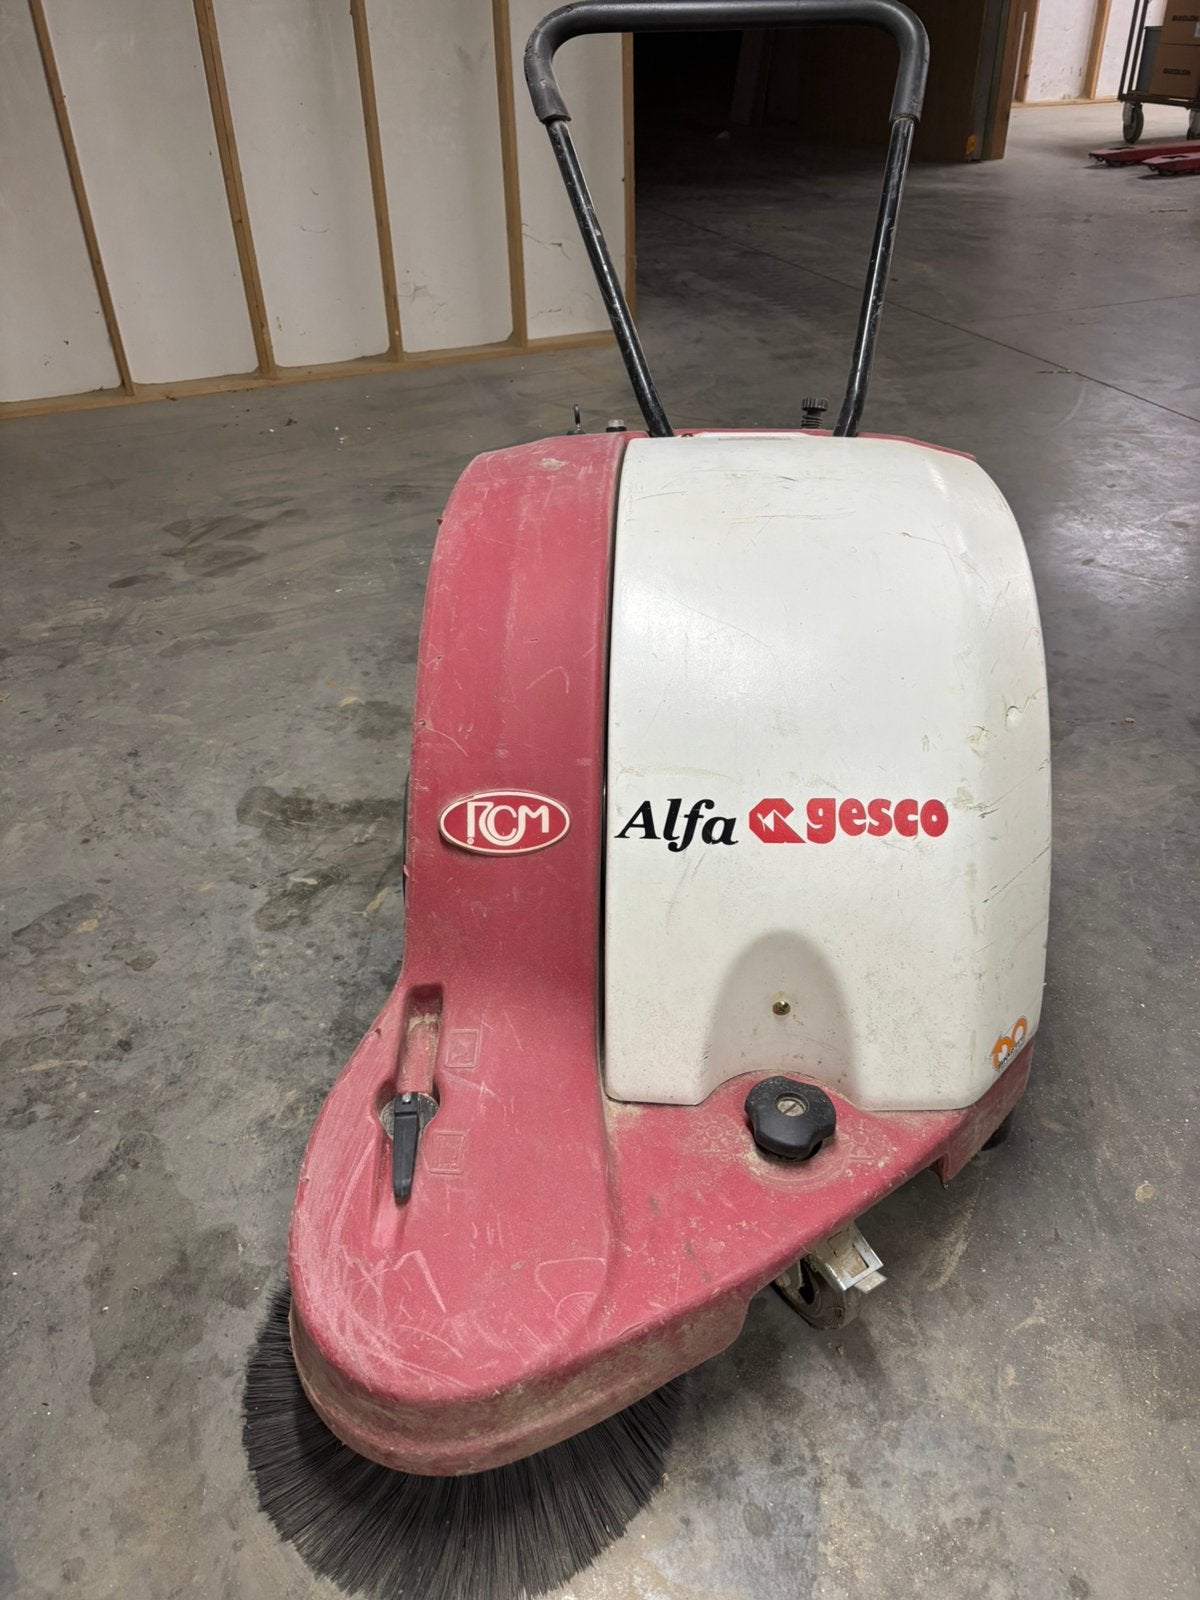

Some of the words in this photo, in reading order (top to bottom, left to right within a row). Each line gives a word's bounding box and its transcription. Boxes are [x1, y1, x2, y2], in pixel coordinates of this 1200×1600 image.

[466, 801, 550, 847] RCM
[614, 798, 739, 853] Alfa
[805, 798, 949, 844] gesco
